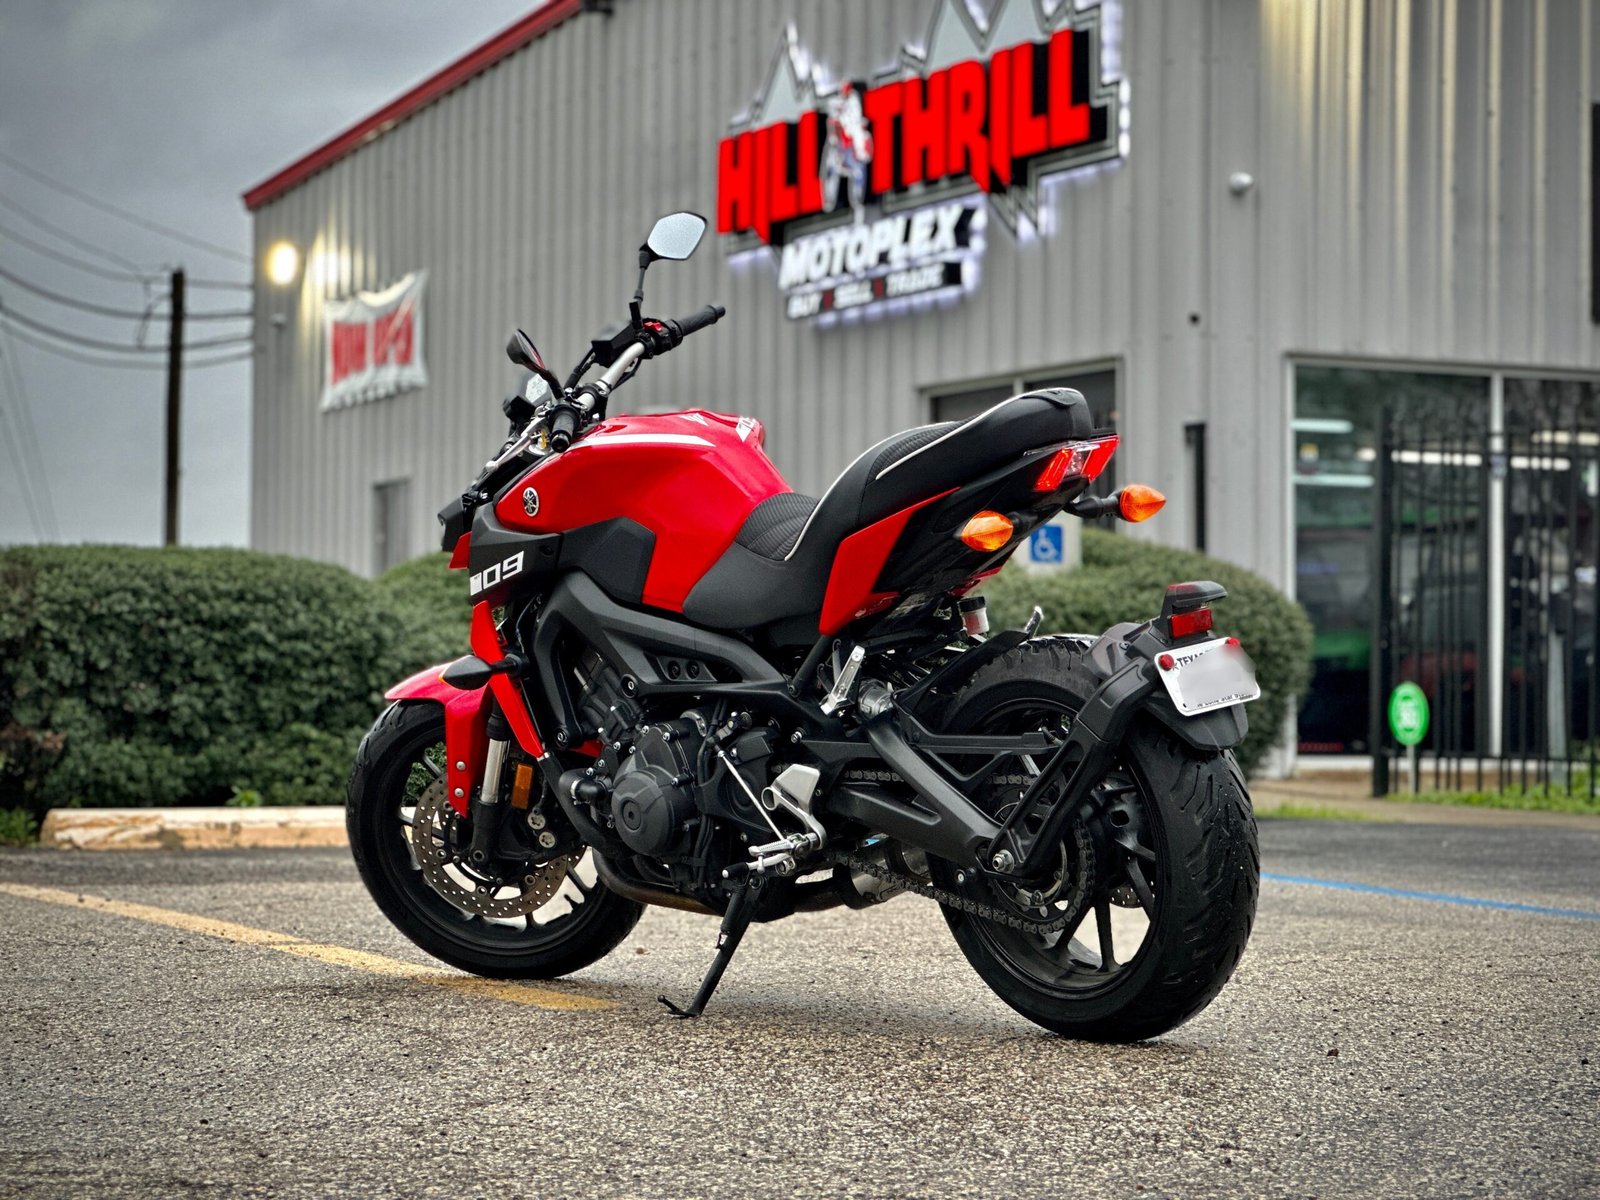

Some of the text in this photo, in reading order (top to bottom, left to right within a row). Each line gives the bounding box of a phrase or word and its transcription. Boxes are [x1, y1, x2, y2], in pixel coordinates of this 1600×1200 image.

[717, 28, 1090, 244] HILL THRILL
[779, 204, 962, 290] MOTOPLEX
